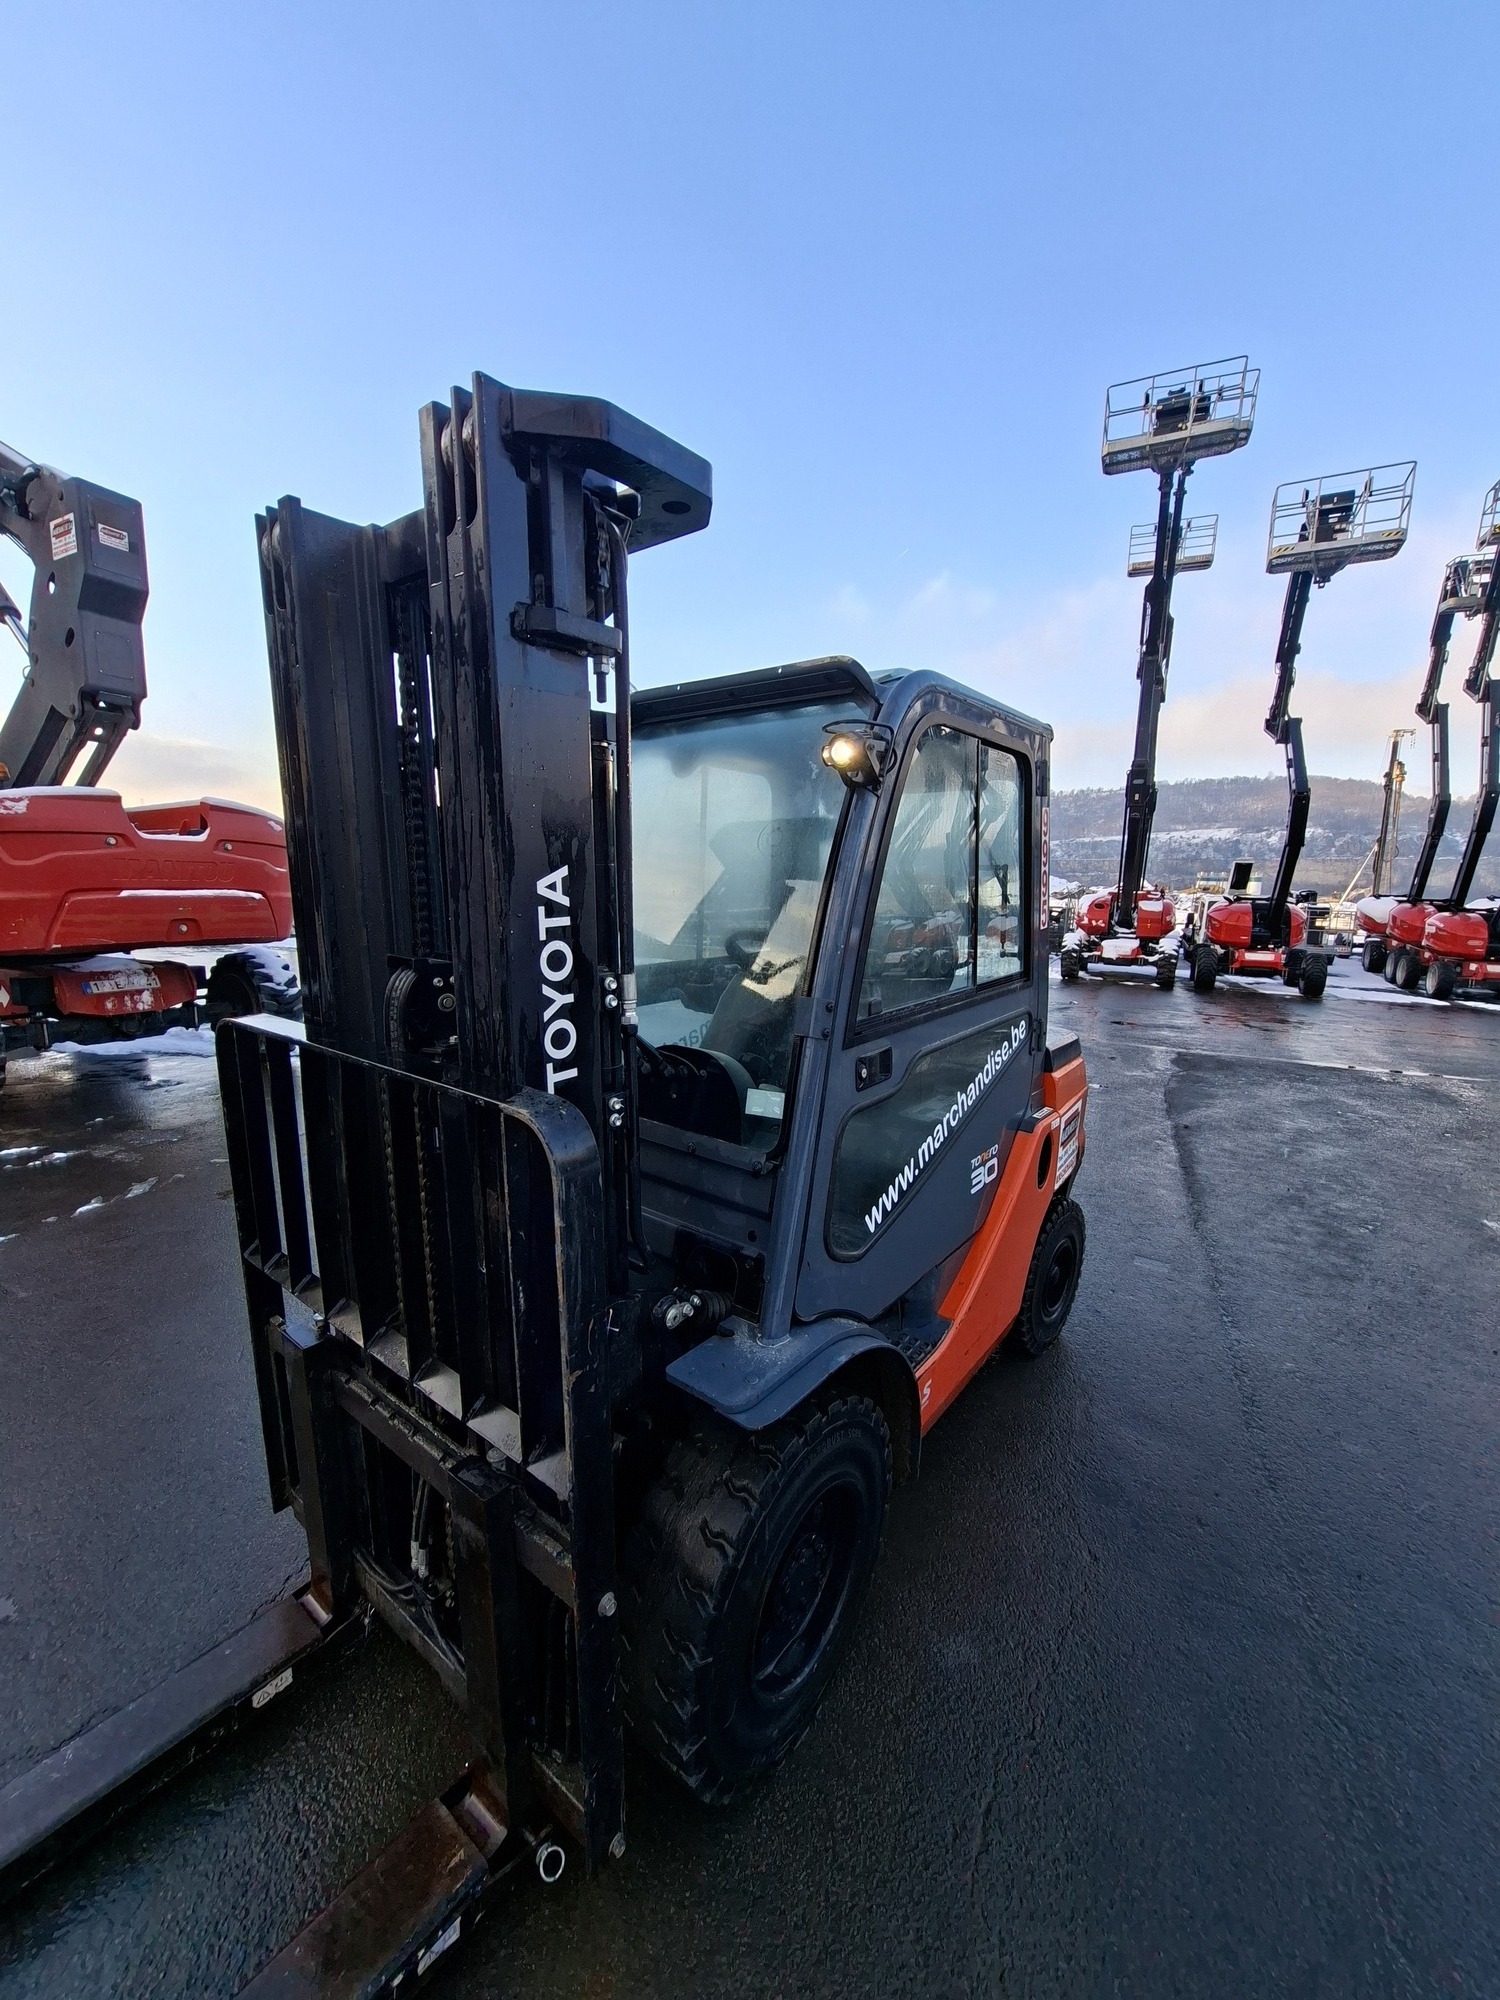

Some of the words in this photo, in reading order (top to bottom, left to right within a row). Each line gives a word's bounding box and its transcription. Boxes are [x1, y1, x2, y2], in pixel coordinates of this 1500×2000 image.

[536, 864, 578, 1095] TOYOTA
[865, 1018, 1027, 1234] www.marchandise.be
[970, 1156, 999, 1195] 30
